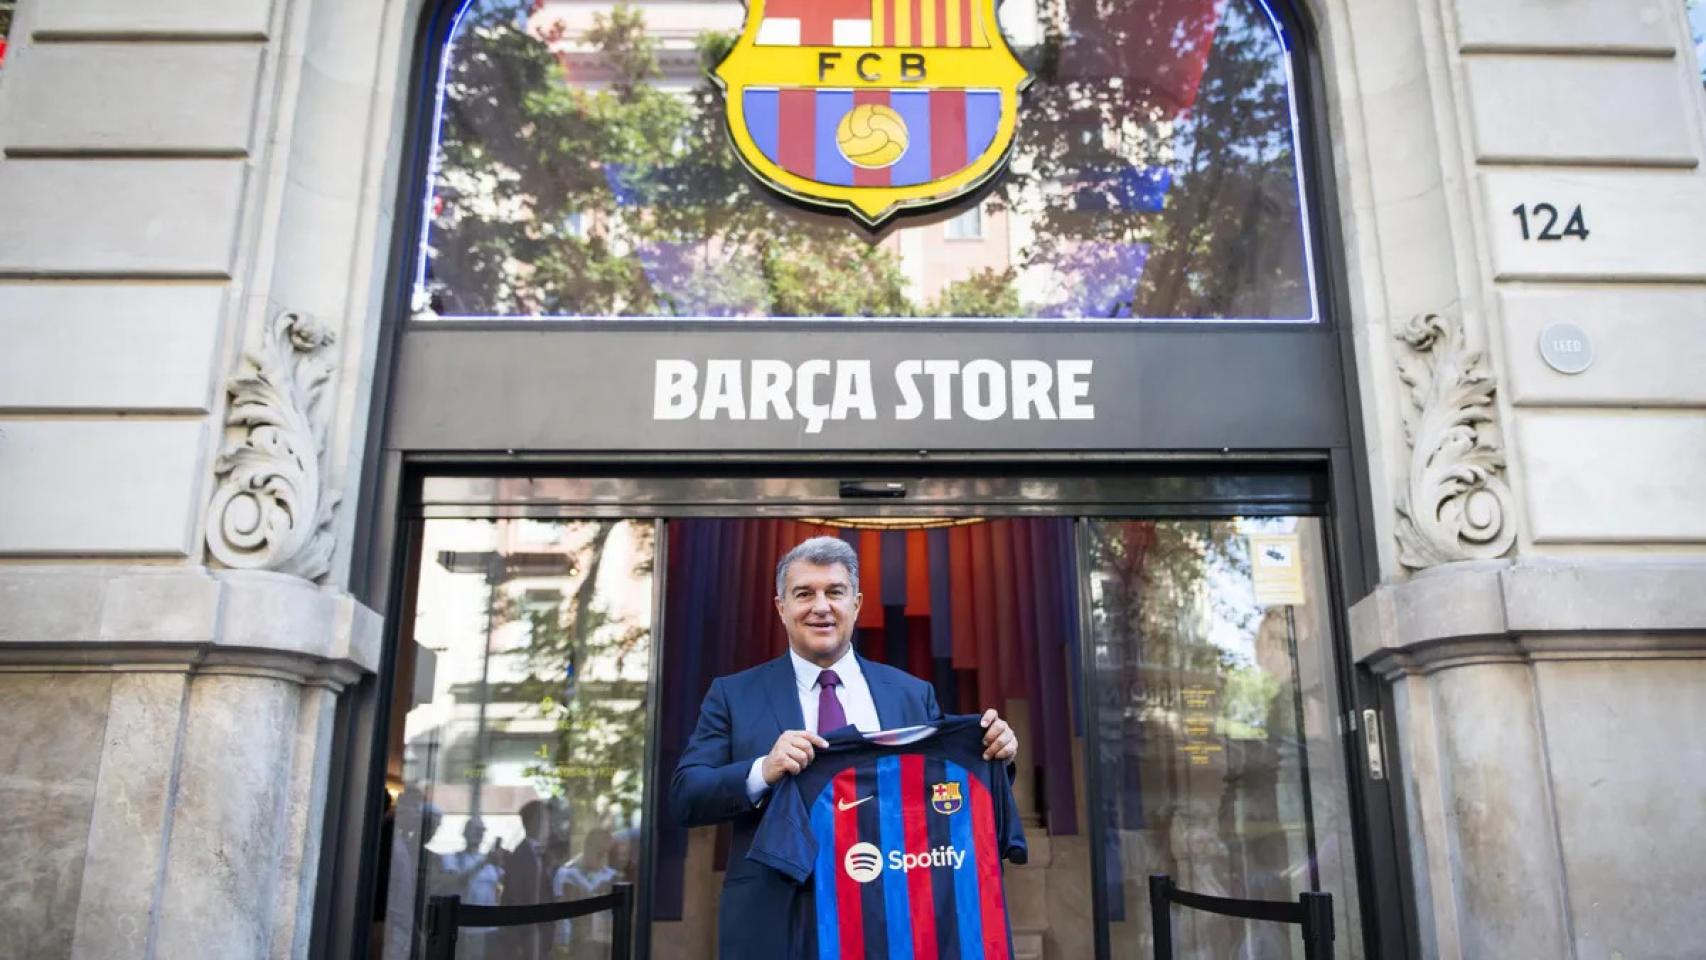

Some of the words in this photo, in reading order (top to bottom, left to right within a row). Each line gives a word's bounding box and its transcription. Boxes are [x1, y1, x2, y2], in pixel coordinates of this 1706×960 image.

[1512, 202, 1590, 241] 124
[1553, 339, 1582, 352] LEED
[653, 359, 877, 434] BARÇA
[894, 359, 1096, 421] STORE
[888, 845, 966, 873] Spotify
